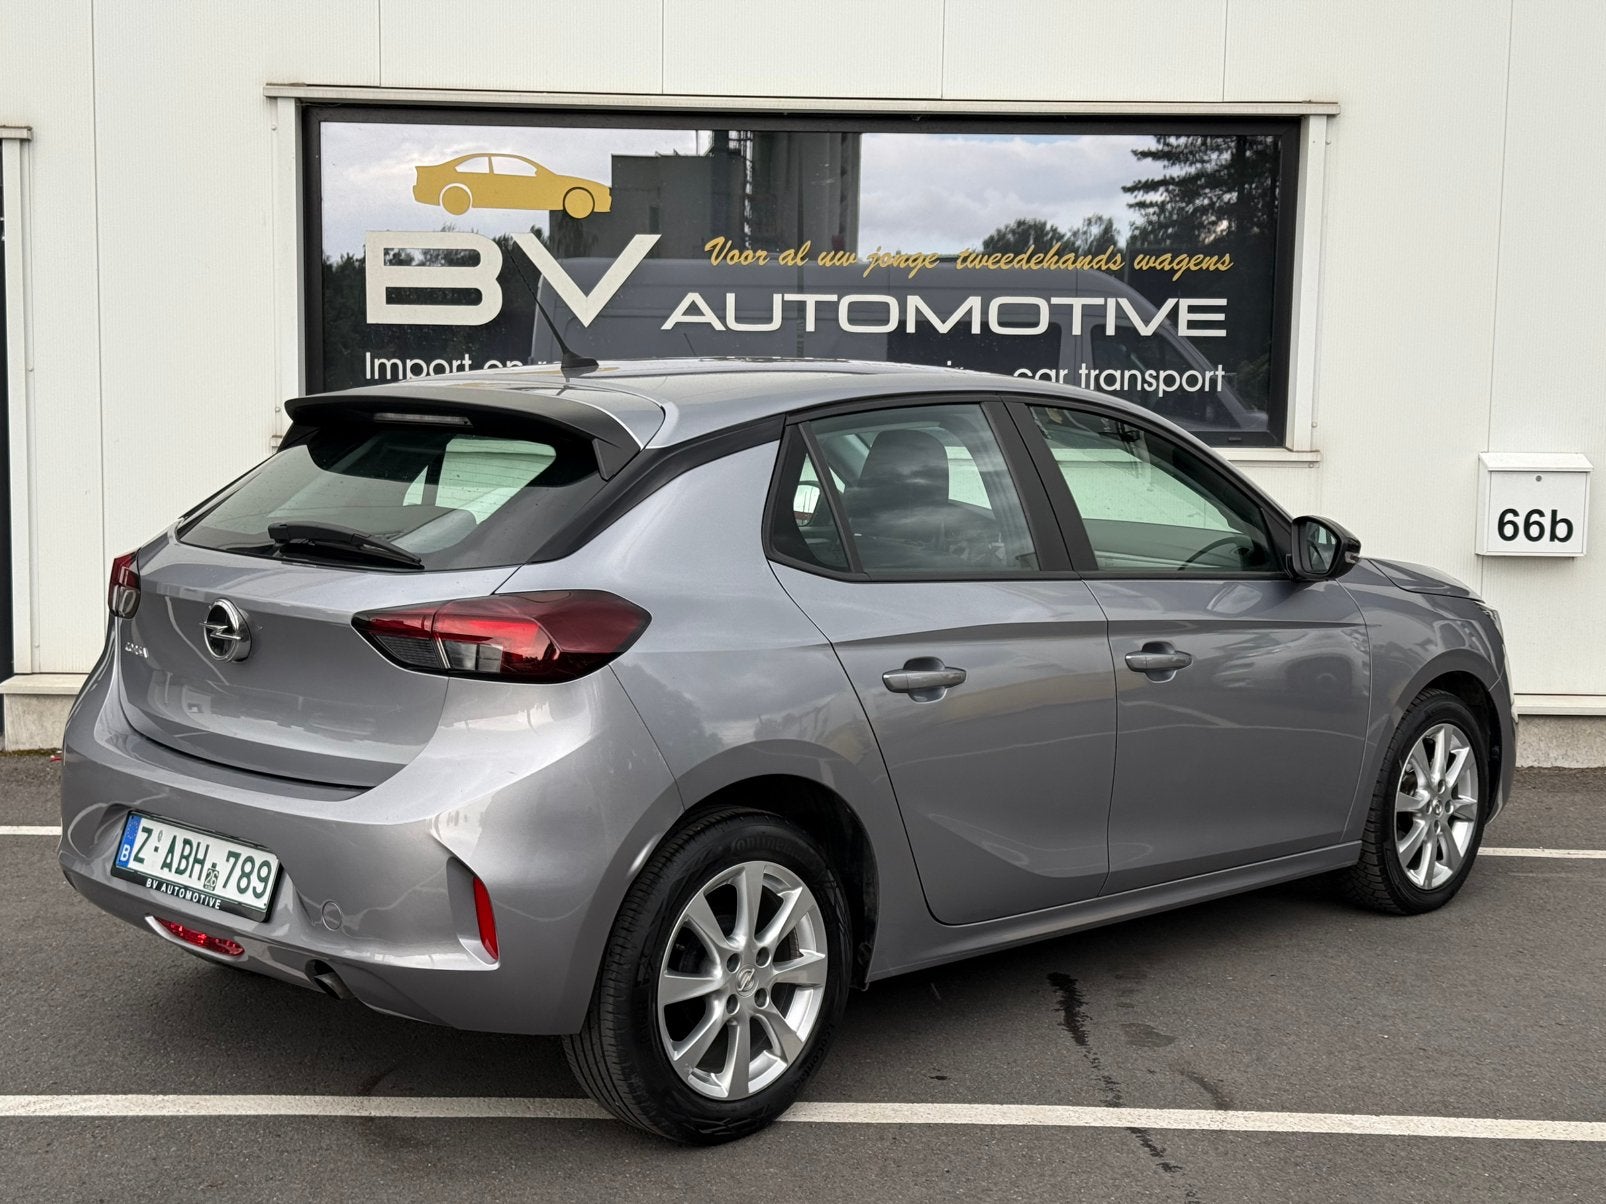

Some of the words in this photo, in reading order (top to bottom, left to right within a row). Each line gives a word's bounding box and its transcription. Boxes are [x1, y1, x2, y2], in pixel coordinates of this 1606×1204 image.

[704, 236, 771, 266] Voor
[778, 240, 812, 266] al
[817, 249, 858, 267] uw
[862, 245, 940, 279] jonge
[955, 242, 1125, 271] tweedehands
[1133, 251, 1234, 282] wagens
[365, 230, 662, 329] BV
[660, 292, 1228, 338] AUTOMOTIVE
[365, 351, 472, 380] Import
[1079, 363, 1225, 398] transport
[1497, 508, 1574, 543] 66b
[120, 844, 131, 862] B
[146, 879, 159, 890] BV
[160, 881, 222, 910] AUTOMOTIVE
